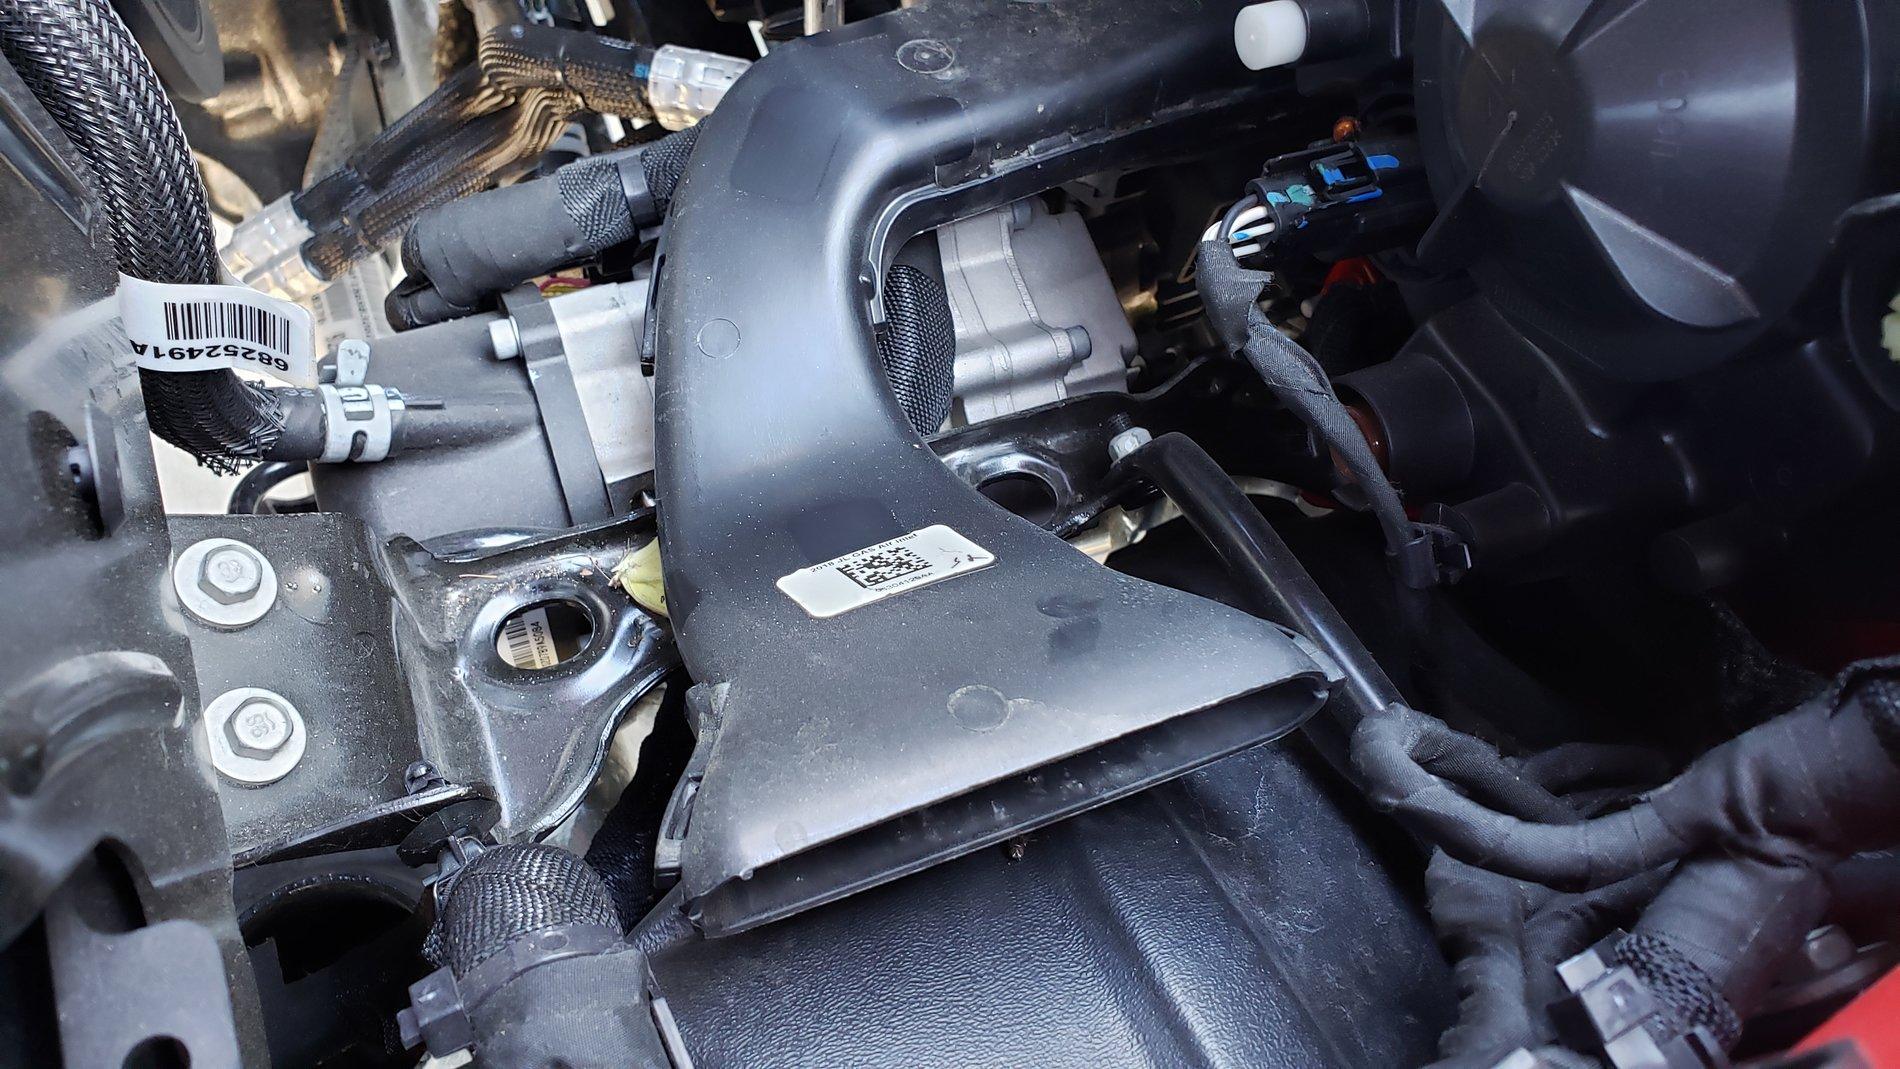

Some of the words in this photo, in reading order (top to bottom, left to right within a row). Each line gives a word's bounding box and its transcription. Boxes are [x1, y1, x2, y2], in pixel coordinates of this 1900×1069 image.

[129, 338, 289, 372] 68252491A
[810, 561, 835, 573] 2018
[852, 547, 876, 557] GAS
[878, 541, 893, 550] Air
